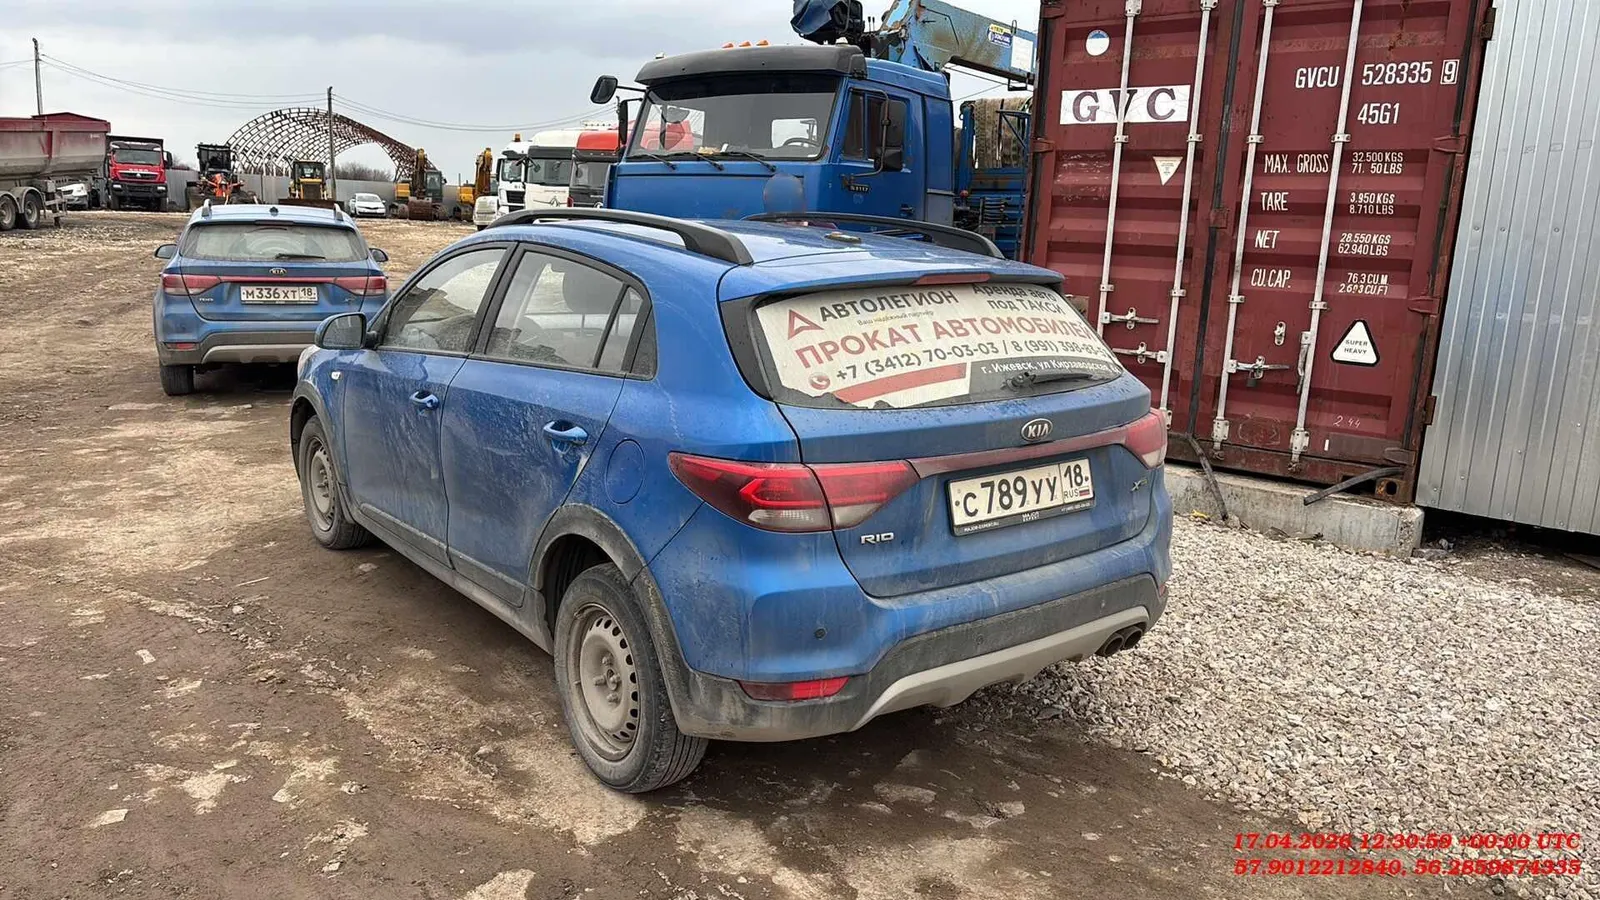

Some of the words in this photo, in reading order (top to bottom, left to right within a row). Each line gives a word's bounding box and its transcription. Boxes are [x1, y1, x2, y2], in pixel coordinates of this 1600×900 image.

[1295, 66, 1340, 88] GVCU
[1362, 61, 1433, 86] 528335
[1444, 61, 1457, 83] 9
[1072, 87, 1176, 122] GVC
[1357, 102, 1400, 124] 45G1
[1264, 154, 1291, 173] MAX.
[1296, 154, 1329, 173] GROSS
[1352, 152, 1383, 162] 32.500
[1385, 152, 1404, 162] KGS
[1383, 163, 1403, 174] LBS
[1261, 192, 1289, 211] TARE
[1350, 192, 1375, 203] 3.950
[1376, 193, 1395, 204] KGS
[1349, 204, 1374, 214] 8.710
[1375, 205, 1394, 215] LBS
[1254, 230, 1280, 249] NET
[1371, 234, 1391, 245] KGS
[1369, 245, 1388, 256] LBS
[300, 287, 313, 296] 18
[972, 286, 1027, 297] Аренда
[820, 290, 959, 322] АВТОЛЕГИОН
[987, 300, 1020, 311] под
[1016, 299, 1066, 315] ТАКСИ
[795, 324, 923, 369] ПРОКАТ
[932, 316, 1093, 340] АВТОМОБИЛЕЙ
[836, 365, 858, 380] +7
[865, 352, 922, 375] (3412)
[923, 342, 999, 362] 70-03-03
[1013, 341, 1022, 352] 8
[1026, 340, 1059, 353] (991)
[1026, 424, 1049, 438] KIA
[1064, 464, 1084, 488] 18
[1063, 488, 1079, 498] RUS
[861, 532, 894, 544] RIO
